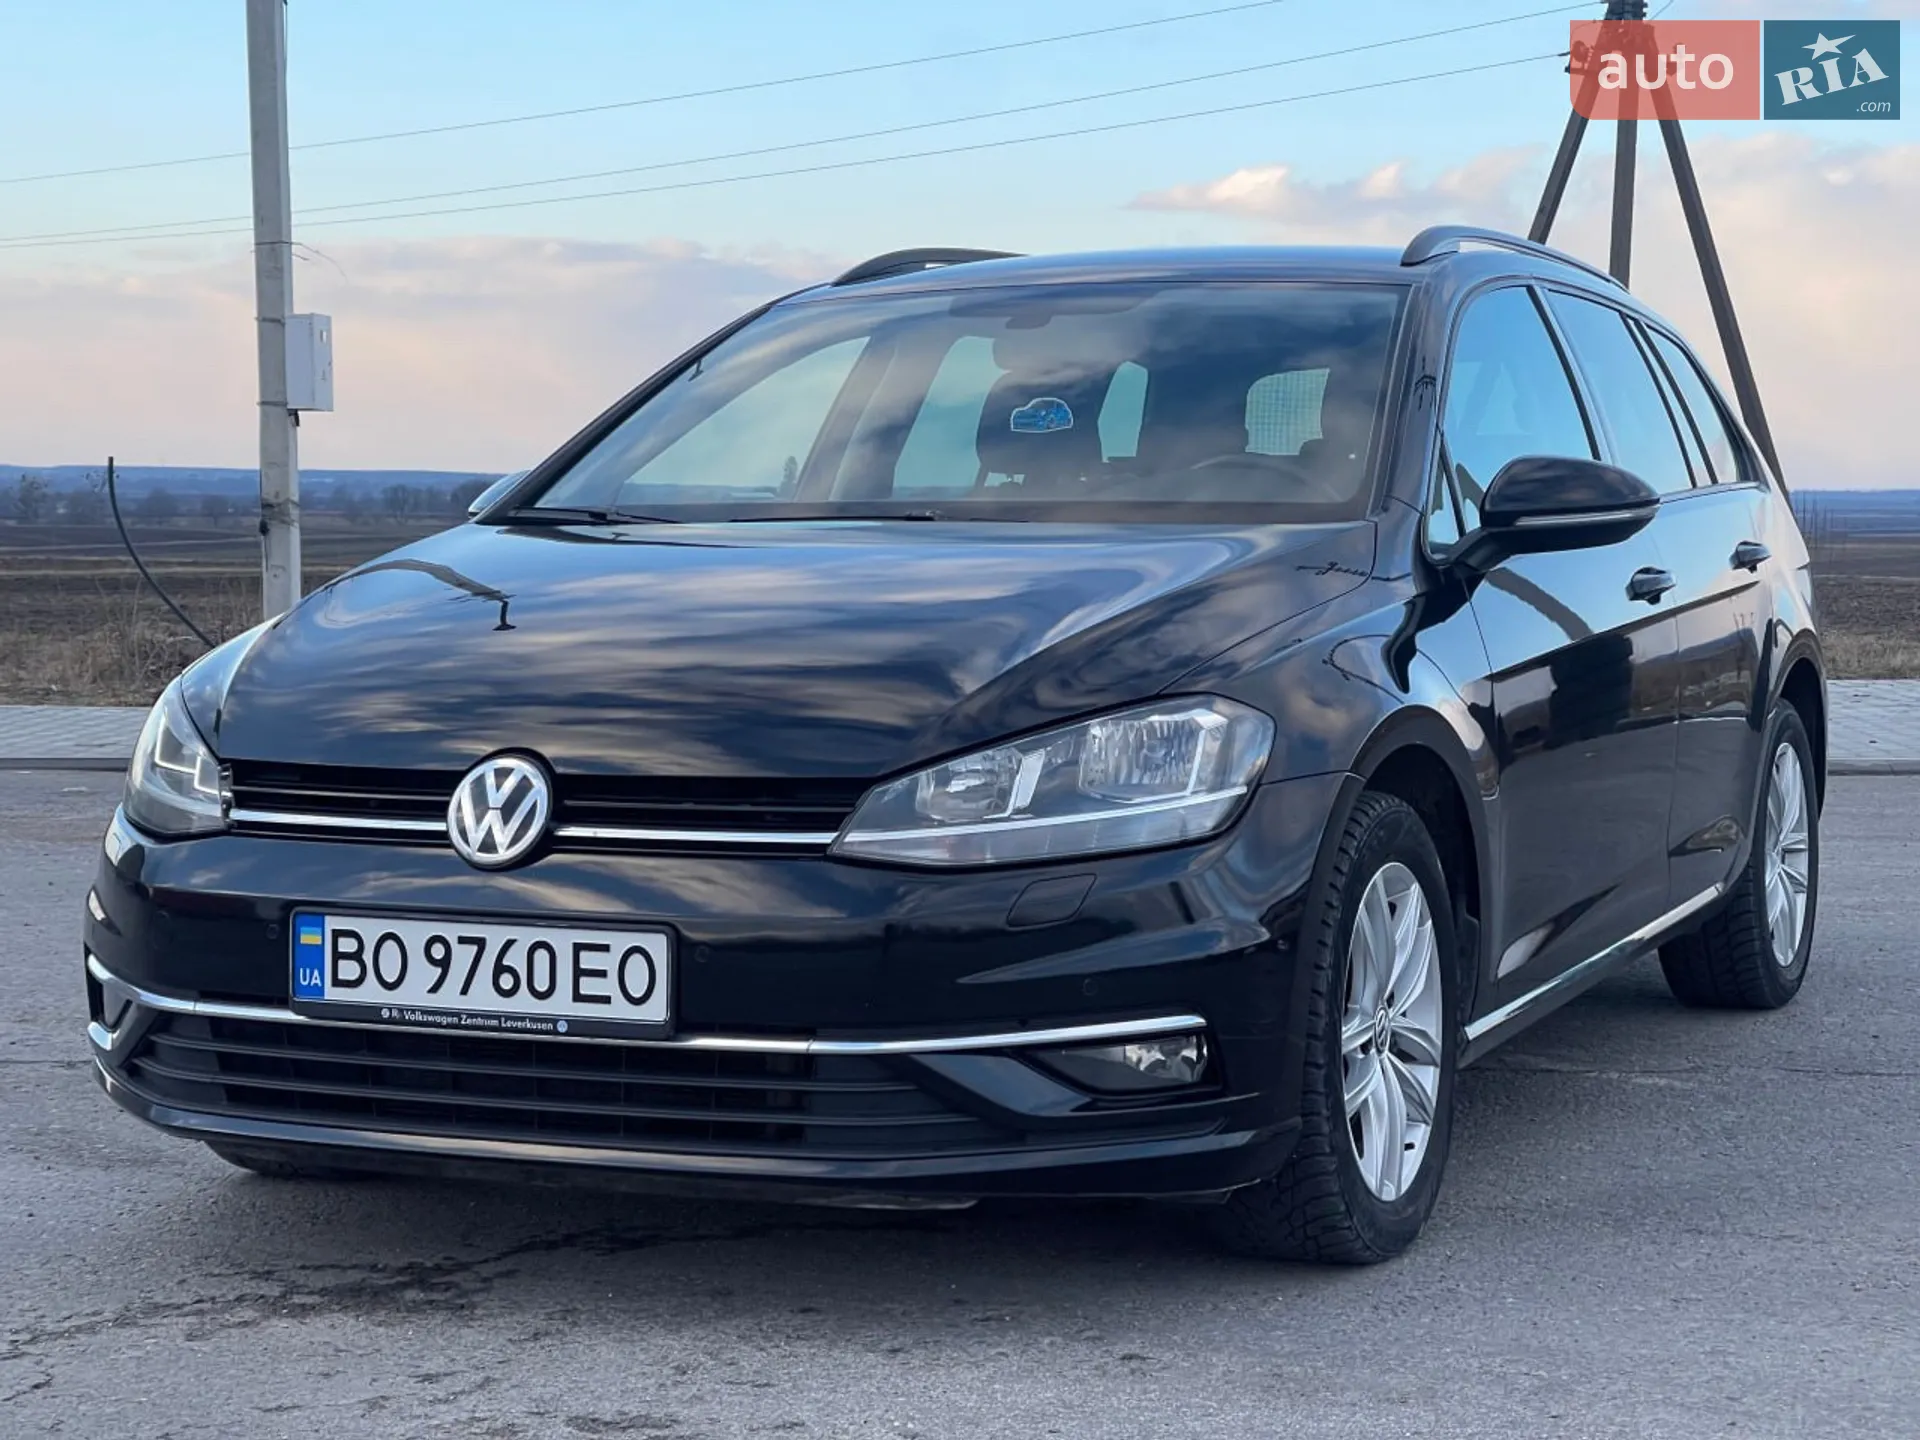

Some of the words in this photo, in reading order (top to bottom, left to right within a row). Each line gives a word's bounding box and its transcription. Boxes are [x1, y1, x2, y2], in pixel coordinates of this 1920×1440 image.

[331, 928, 409, 991] BO
[423, 934, 557, 1000] 9760
[571, 941, 657, 1006] EO
[299, 968, 323, 987] UA
[403, 1010, 458, 1025] Volkswagen
[460, 1014, 499, 1026] Zentrum
[501, 1017, 554, 1030] Leverkusen
